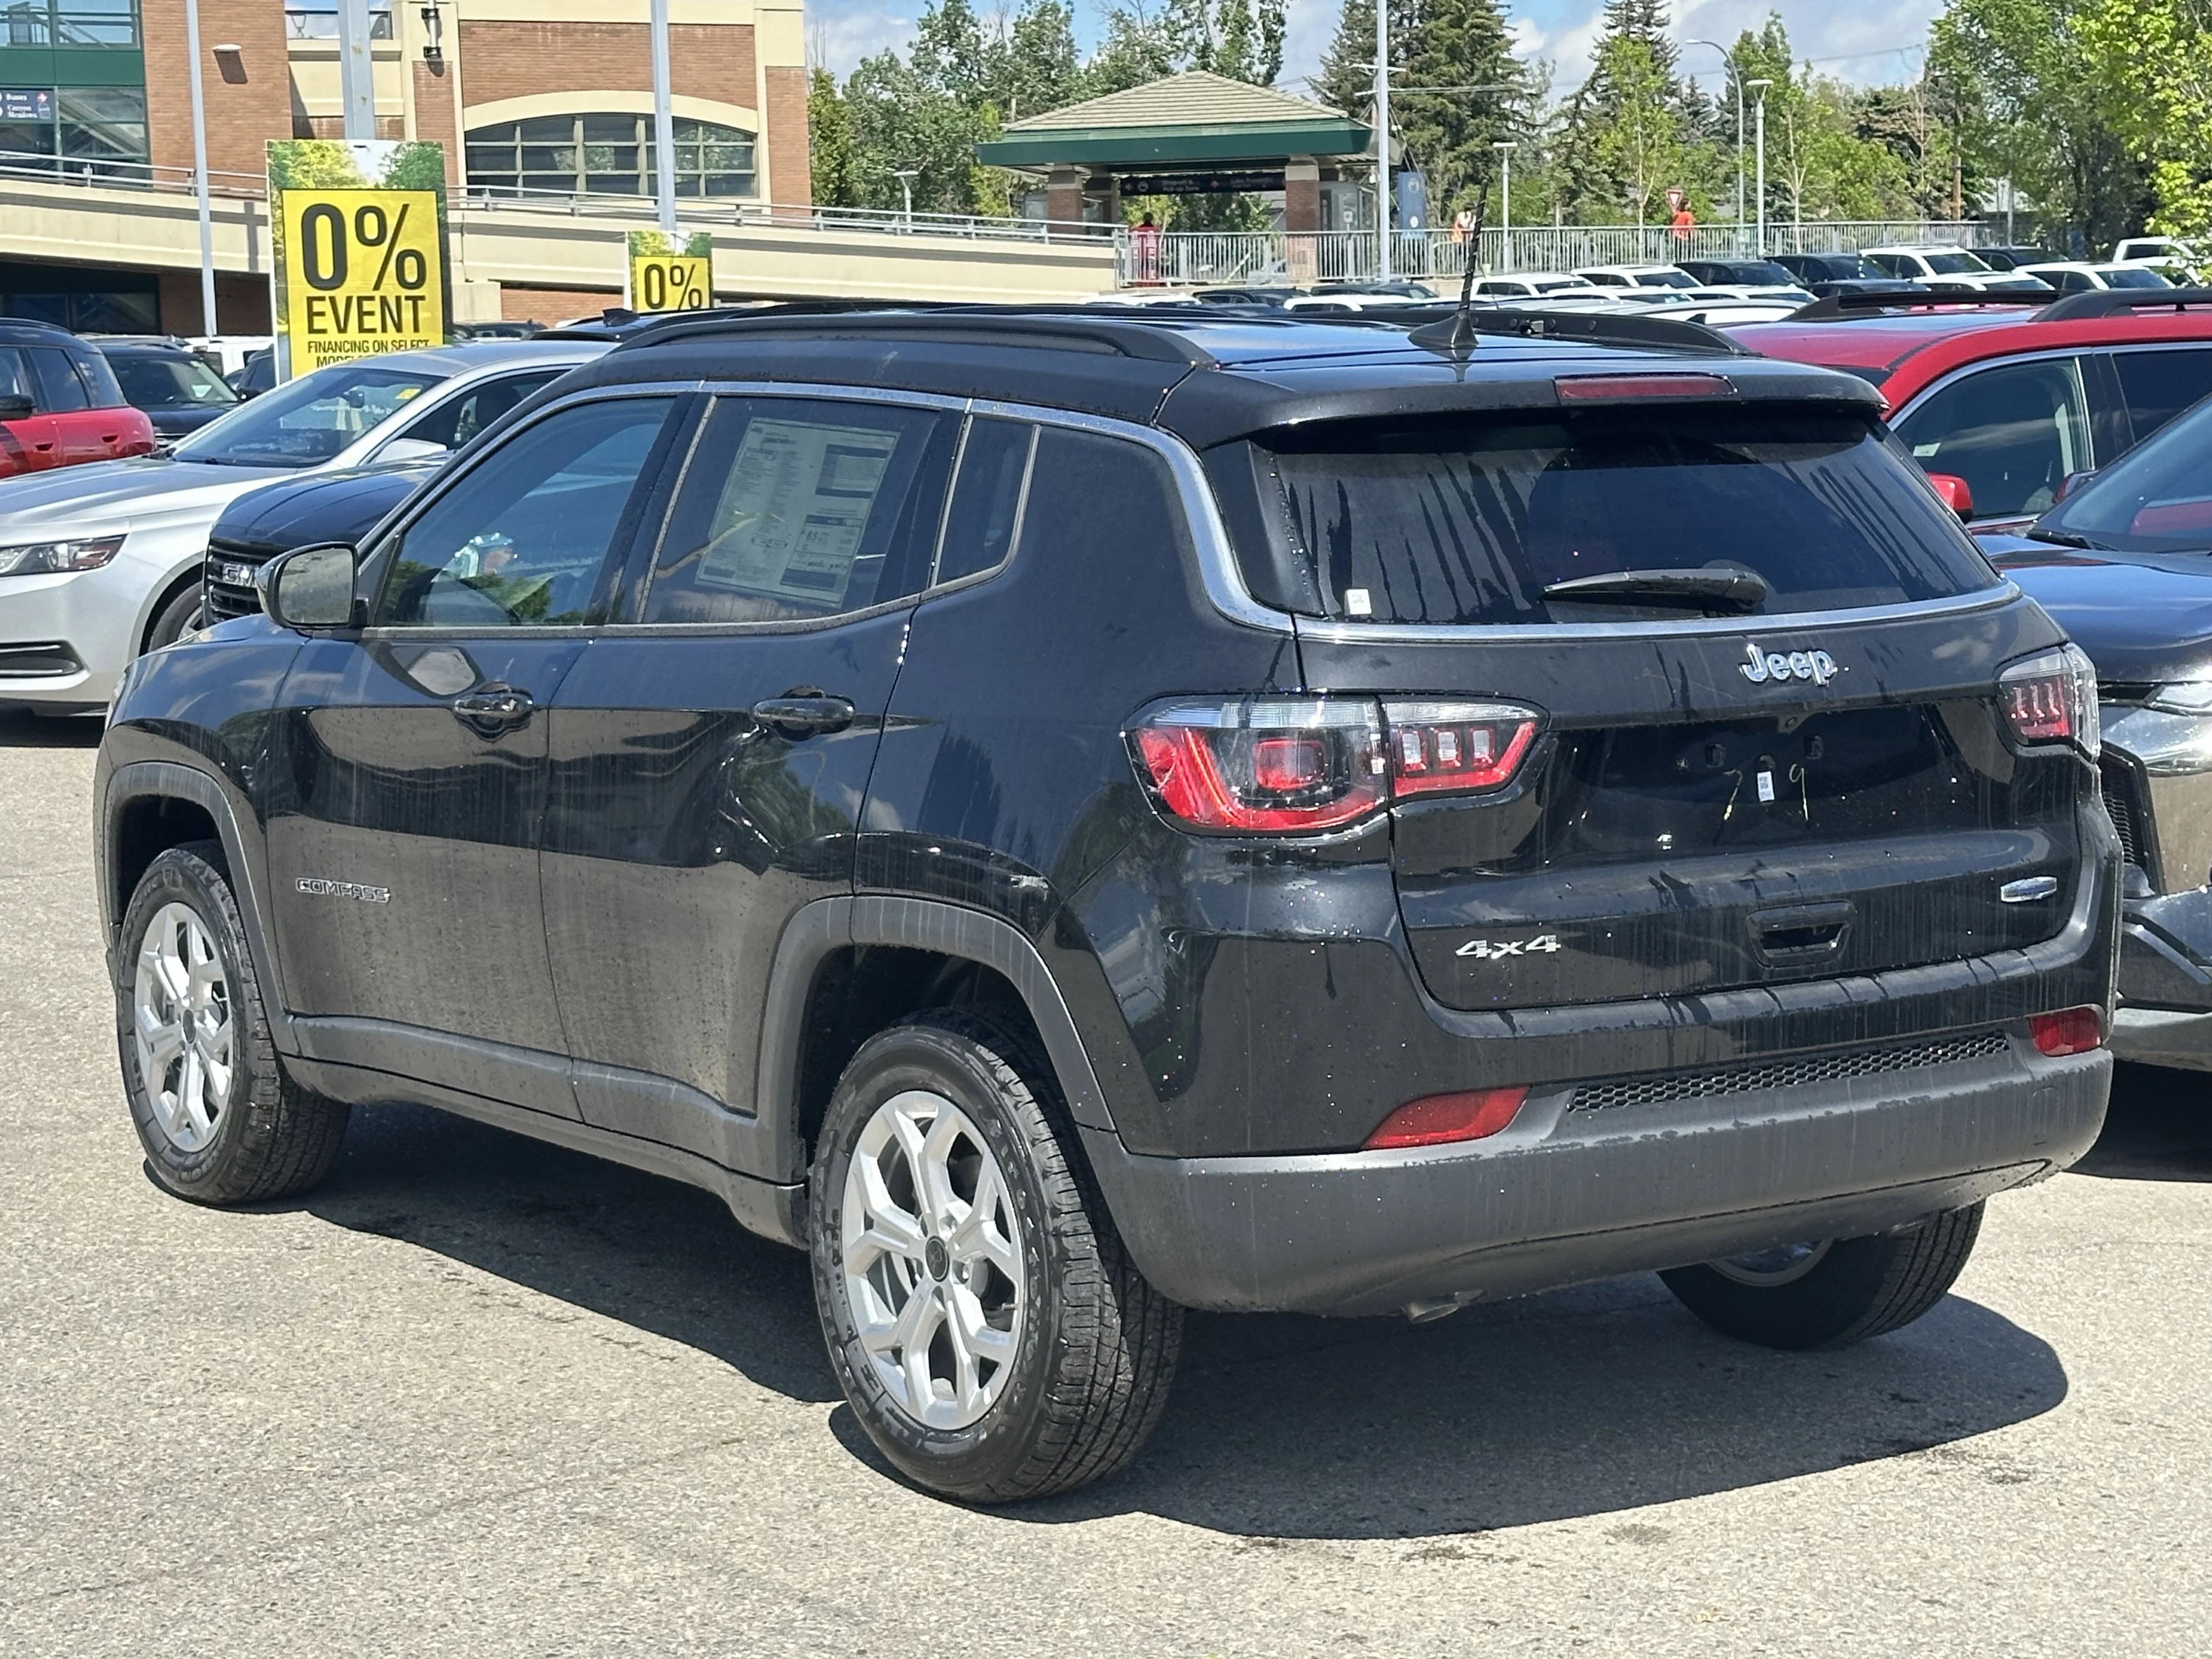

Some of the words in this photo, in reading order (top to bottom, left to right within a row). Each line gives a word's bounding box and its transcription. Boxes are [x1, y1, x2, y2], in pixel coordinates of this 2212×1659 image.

[301, 203, 427, 291] 0%
[644, 263, 703, 311] 0%
[306, 295, 426, 334] EVENT
[308, 340, 370, 353] FINANCING
[373, 339, 388, 353] ON
[223, 563, 260, 588] GM
[1739, 644, 1836, 685] Jeep
[295, 878, 391, 903] COMPASS
[1455, 934, 1561, 960] 4x4
